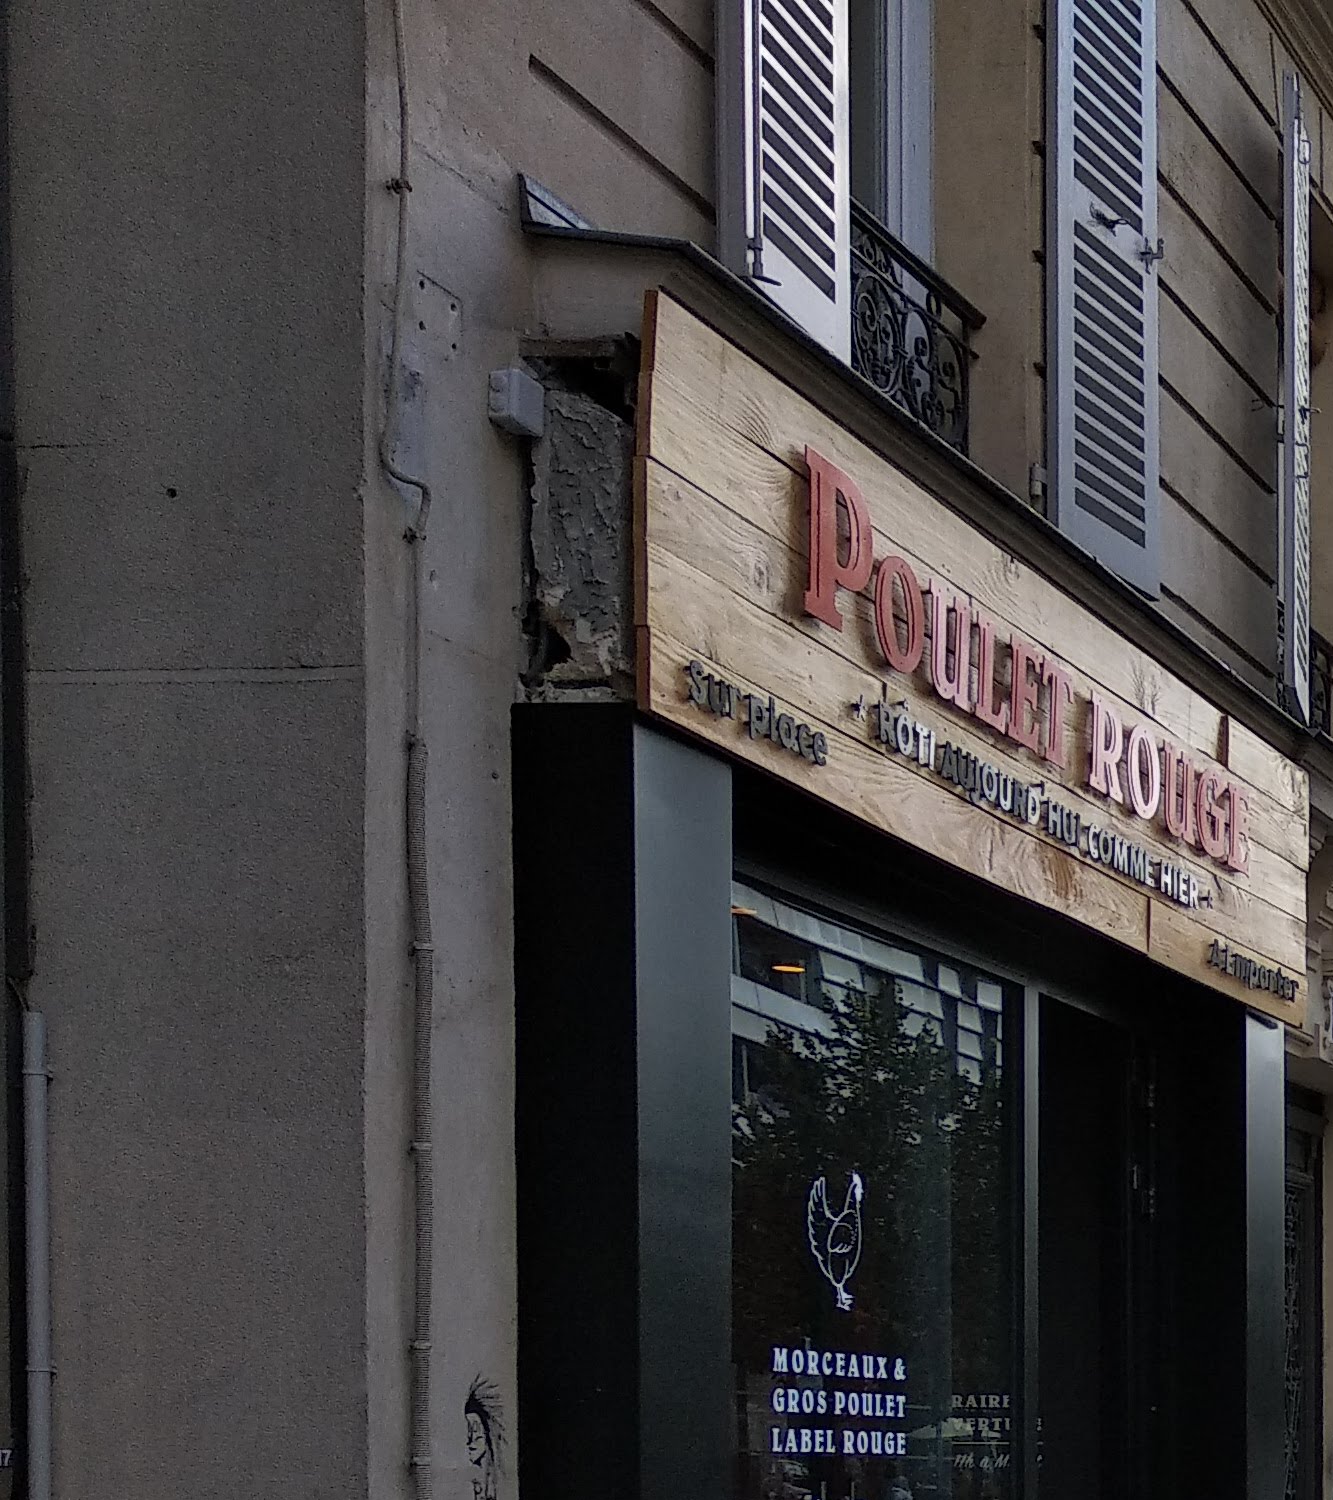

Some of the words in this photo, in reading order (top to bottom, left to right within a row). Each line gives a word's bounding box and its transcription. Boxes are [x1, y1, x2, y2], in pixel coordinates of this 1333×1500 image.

[802, 444, 1073, 770] POULET
[1088, 698, 1250, 874] ROUGE
[686, 658, 741, 720] Sur
[746, 695, 829, 767] place
[1087, 823, 1155, 889] COMME
[1159, 858, 1199, 909] HIER
[772, 1348, 888, 1379] MORCEAUX
[893, 1358, 907, 1381] &
[772, 1388, 828, 1414] GROS
[834, 1390, 907, 1418] POULET
[771, 1428, 837, 1454] LABEL
[843, 1432, 907, 1455] ROUGE
